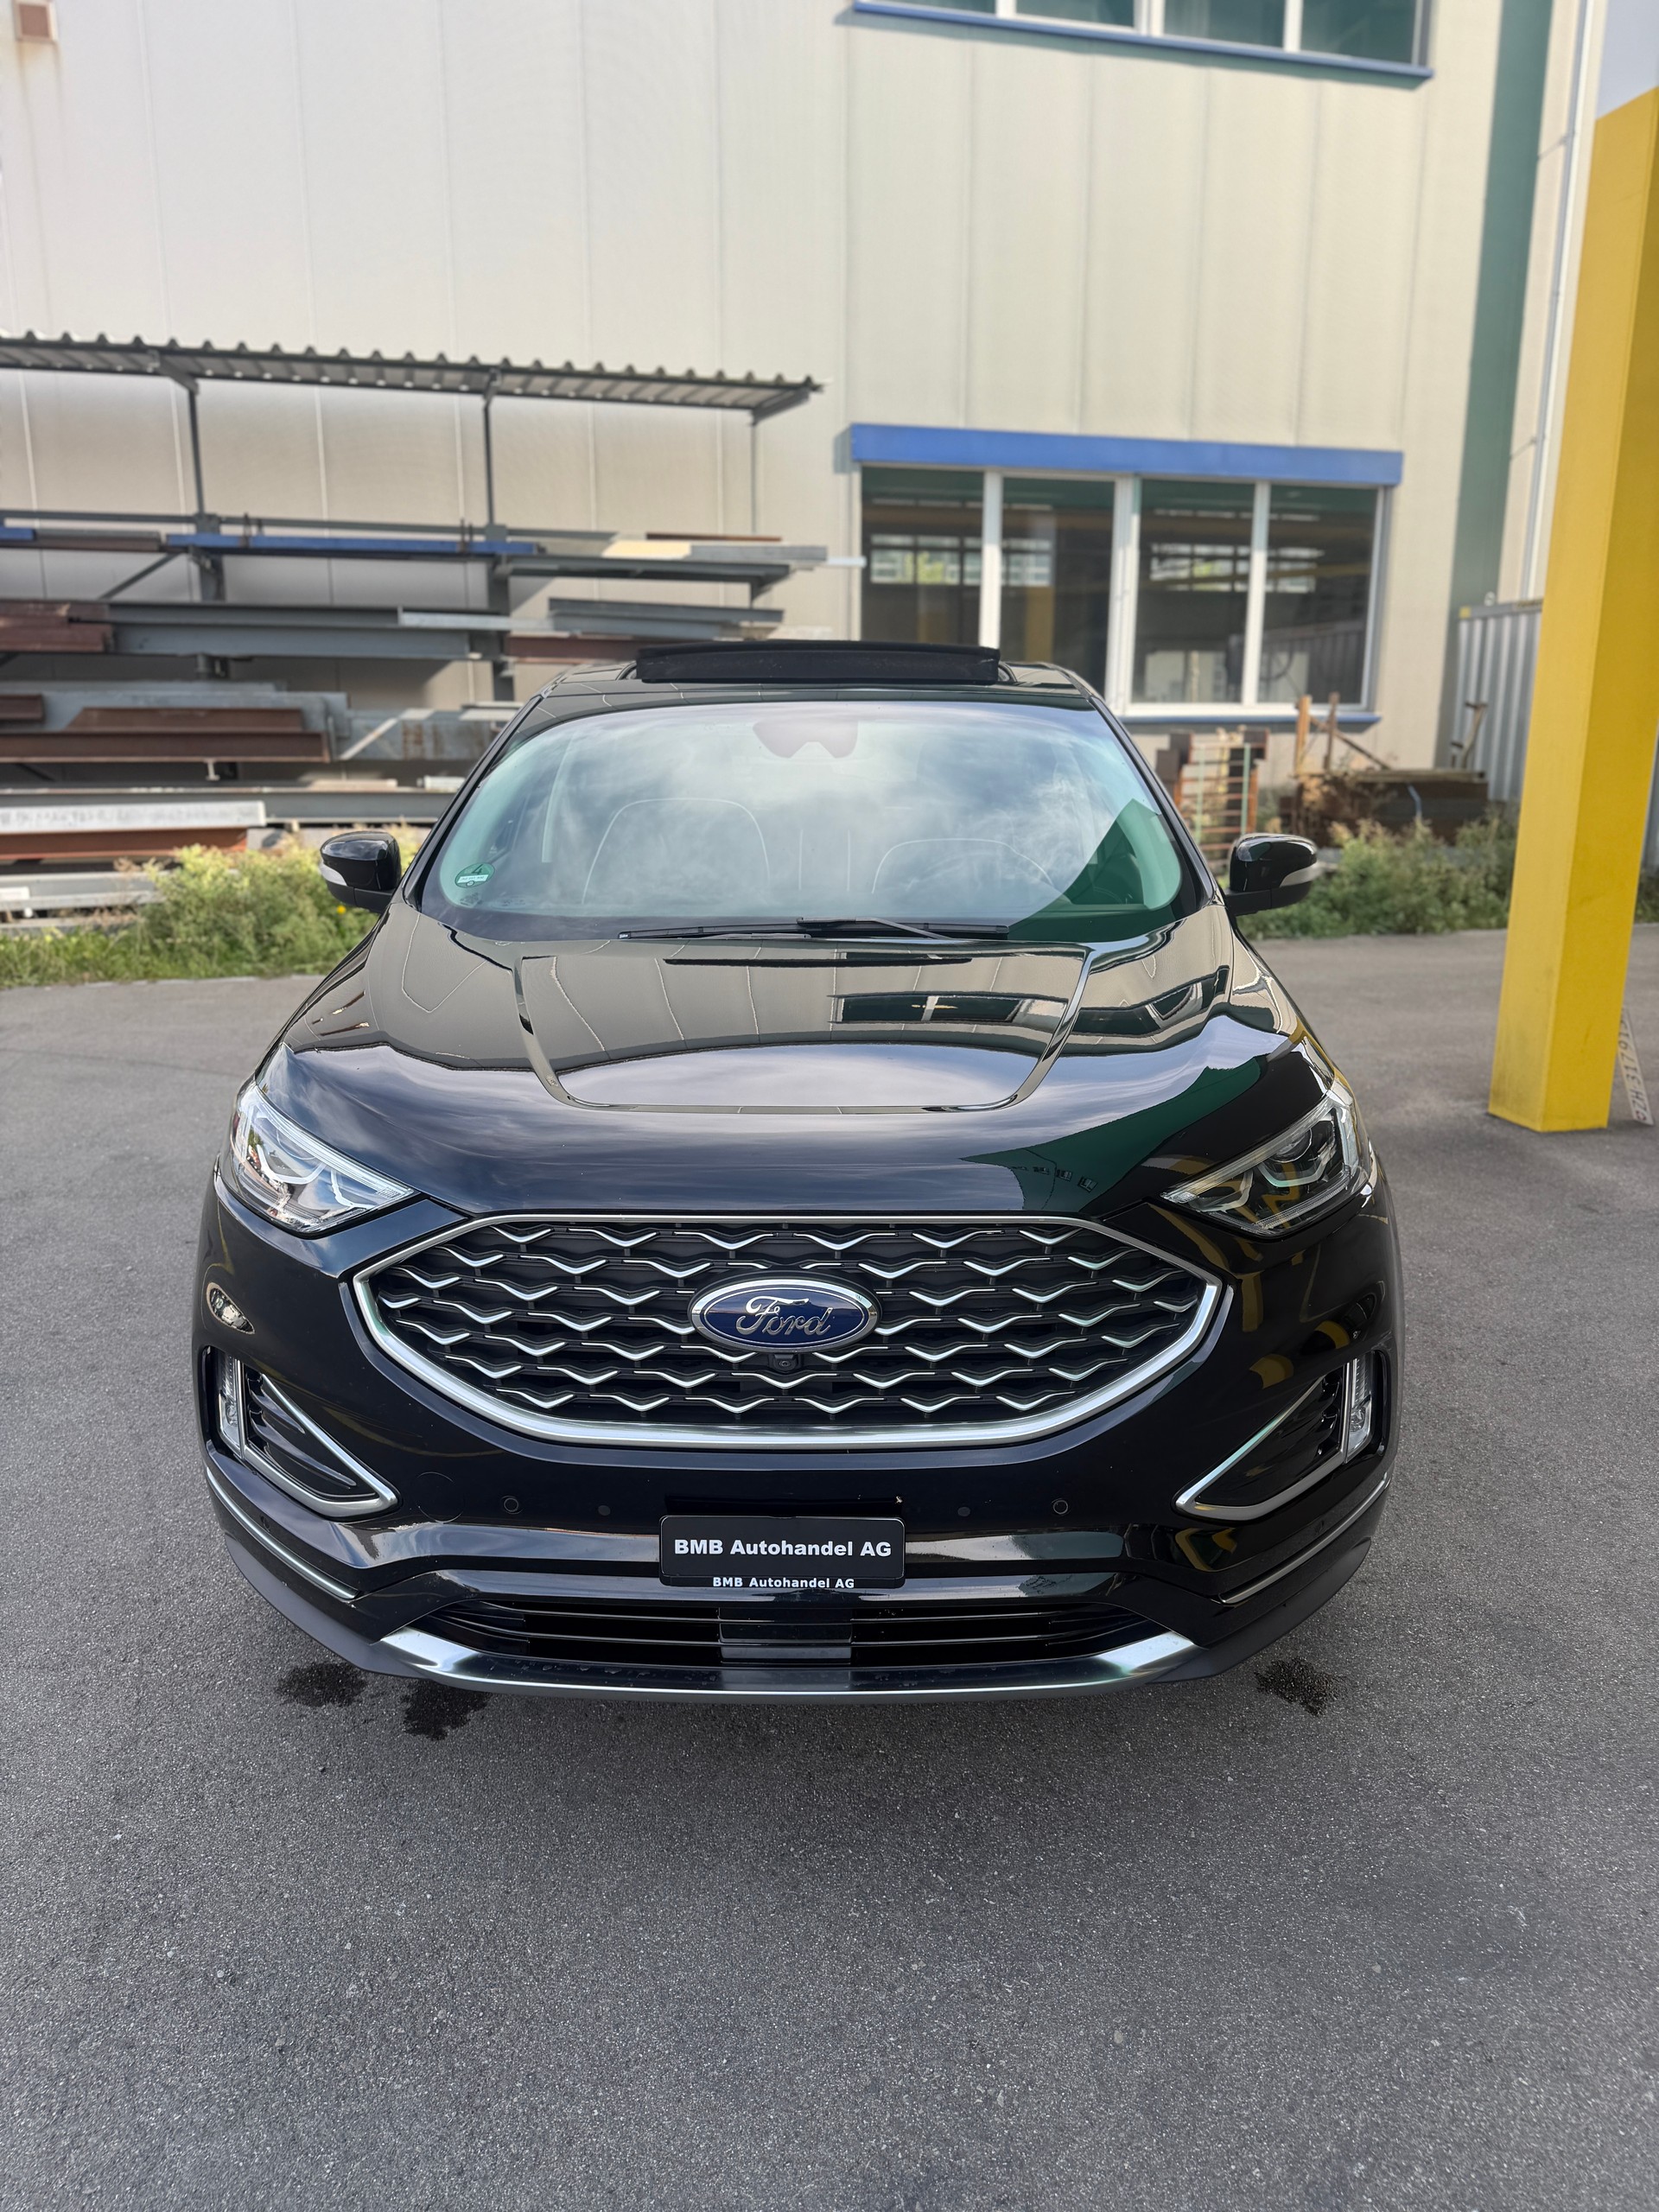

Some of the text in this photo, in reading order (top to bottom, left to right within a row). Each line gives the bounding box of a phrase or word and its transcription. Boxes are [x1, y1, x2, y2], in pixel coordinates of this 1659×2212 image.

[471, 863, 484, 875] 4
[736, 1295, 833, 1336] Ford
[674, 1539, 892, 1557] BMB Autohandel AG
[713, 1577, 855, 1589] BMB Autohandel AG
